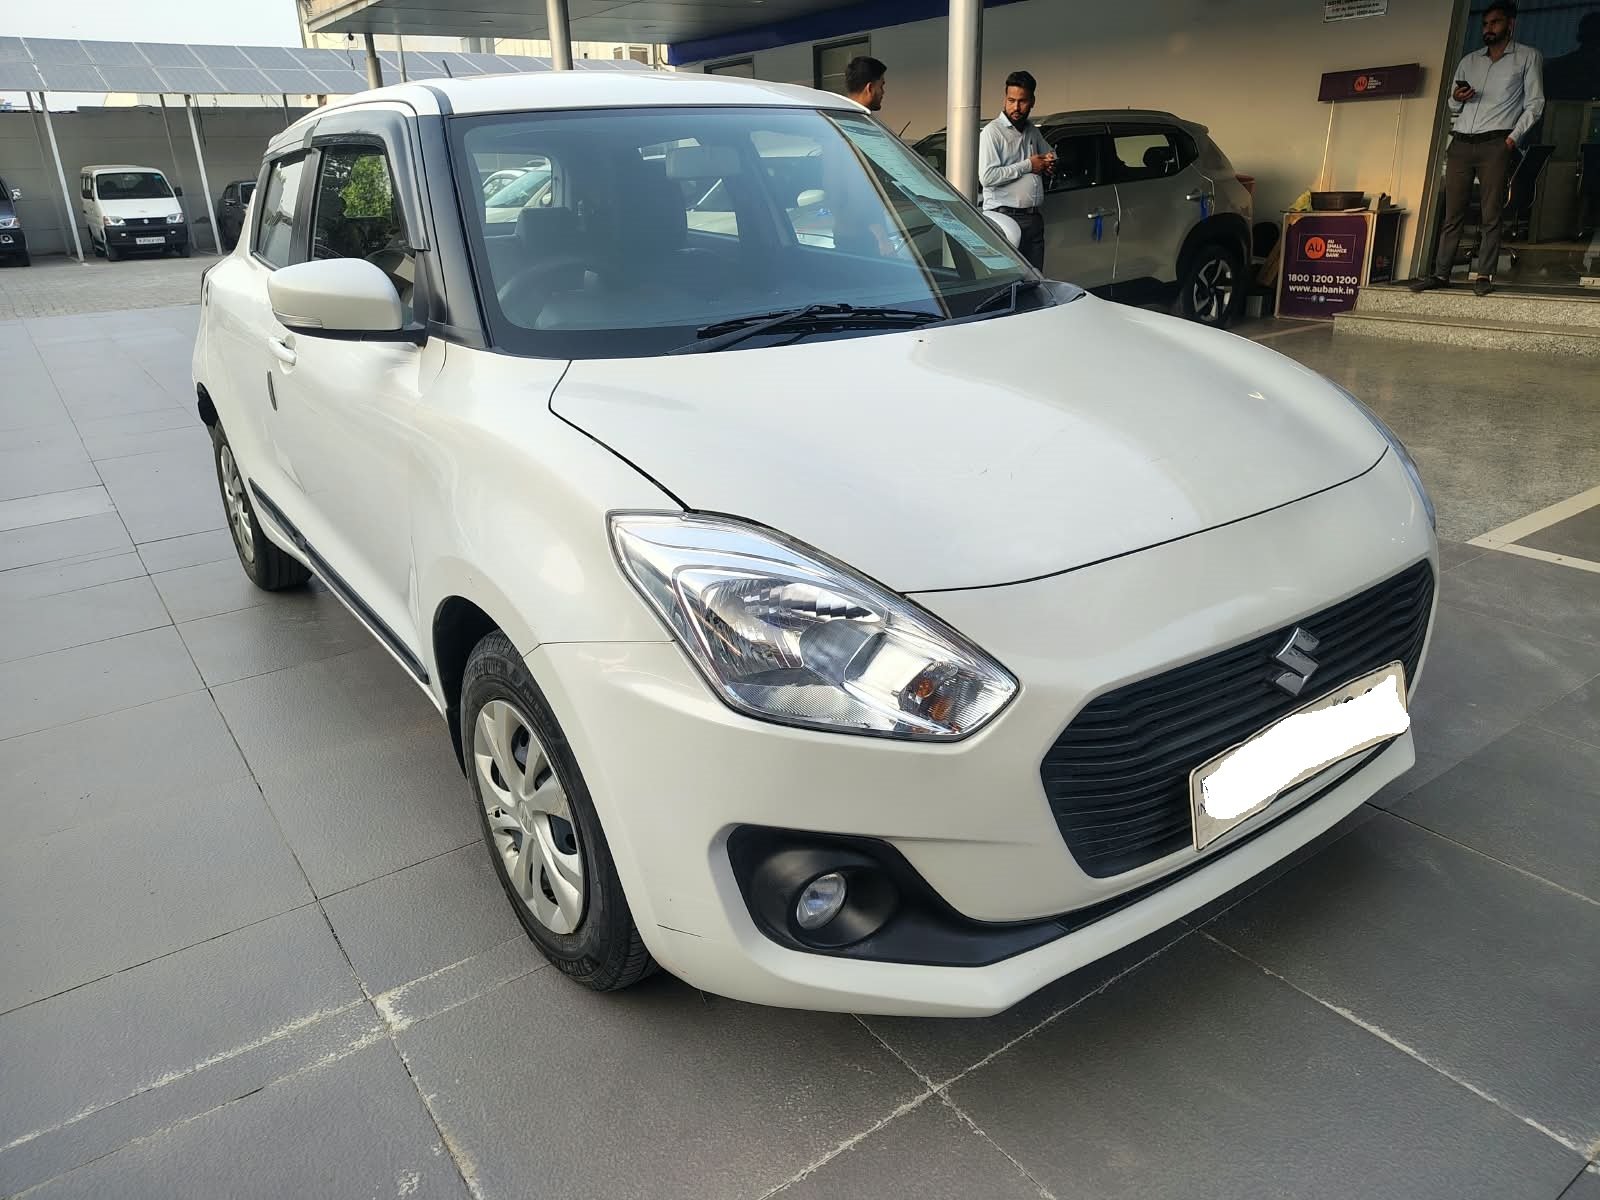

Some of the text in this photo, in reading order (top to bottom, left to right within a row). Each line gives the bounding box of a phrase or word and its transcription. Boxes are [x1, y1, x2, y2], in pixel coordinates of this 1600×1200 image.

[1307, 243, 1322, 252] AU
[1288, 274, 1358, 285] 1800 1200 1200
[1288, 285, 1354, 295] www.aubank.in
